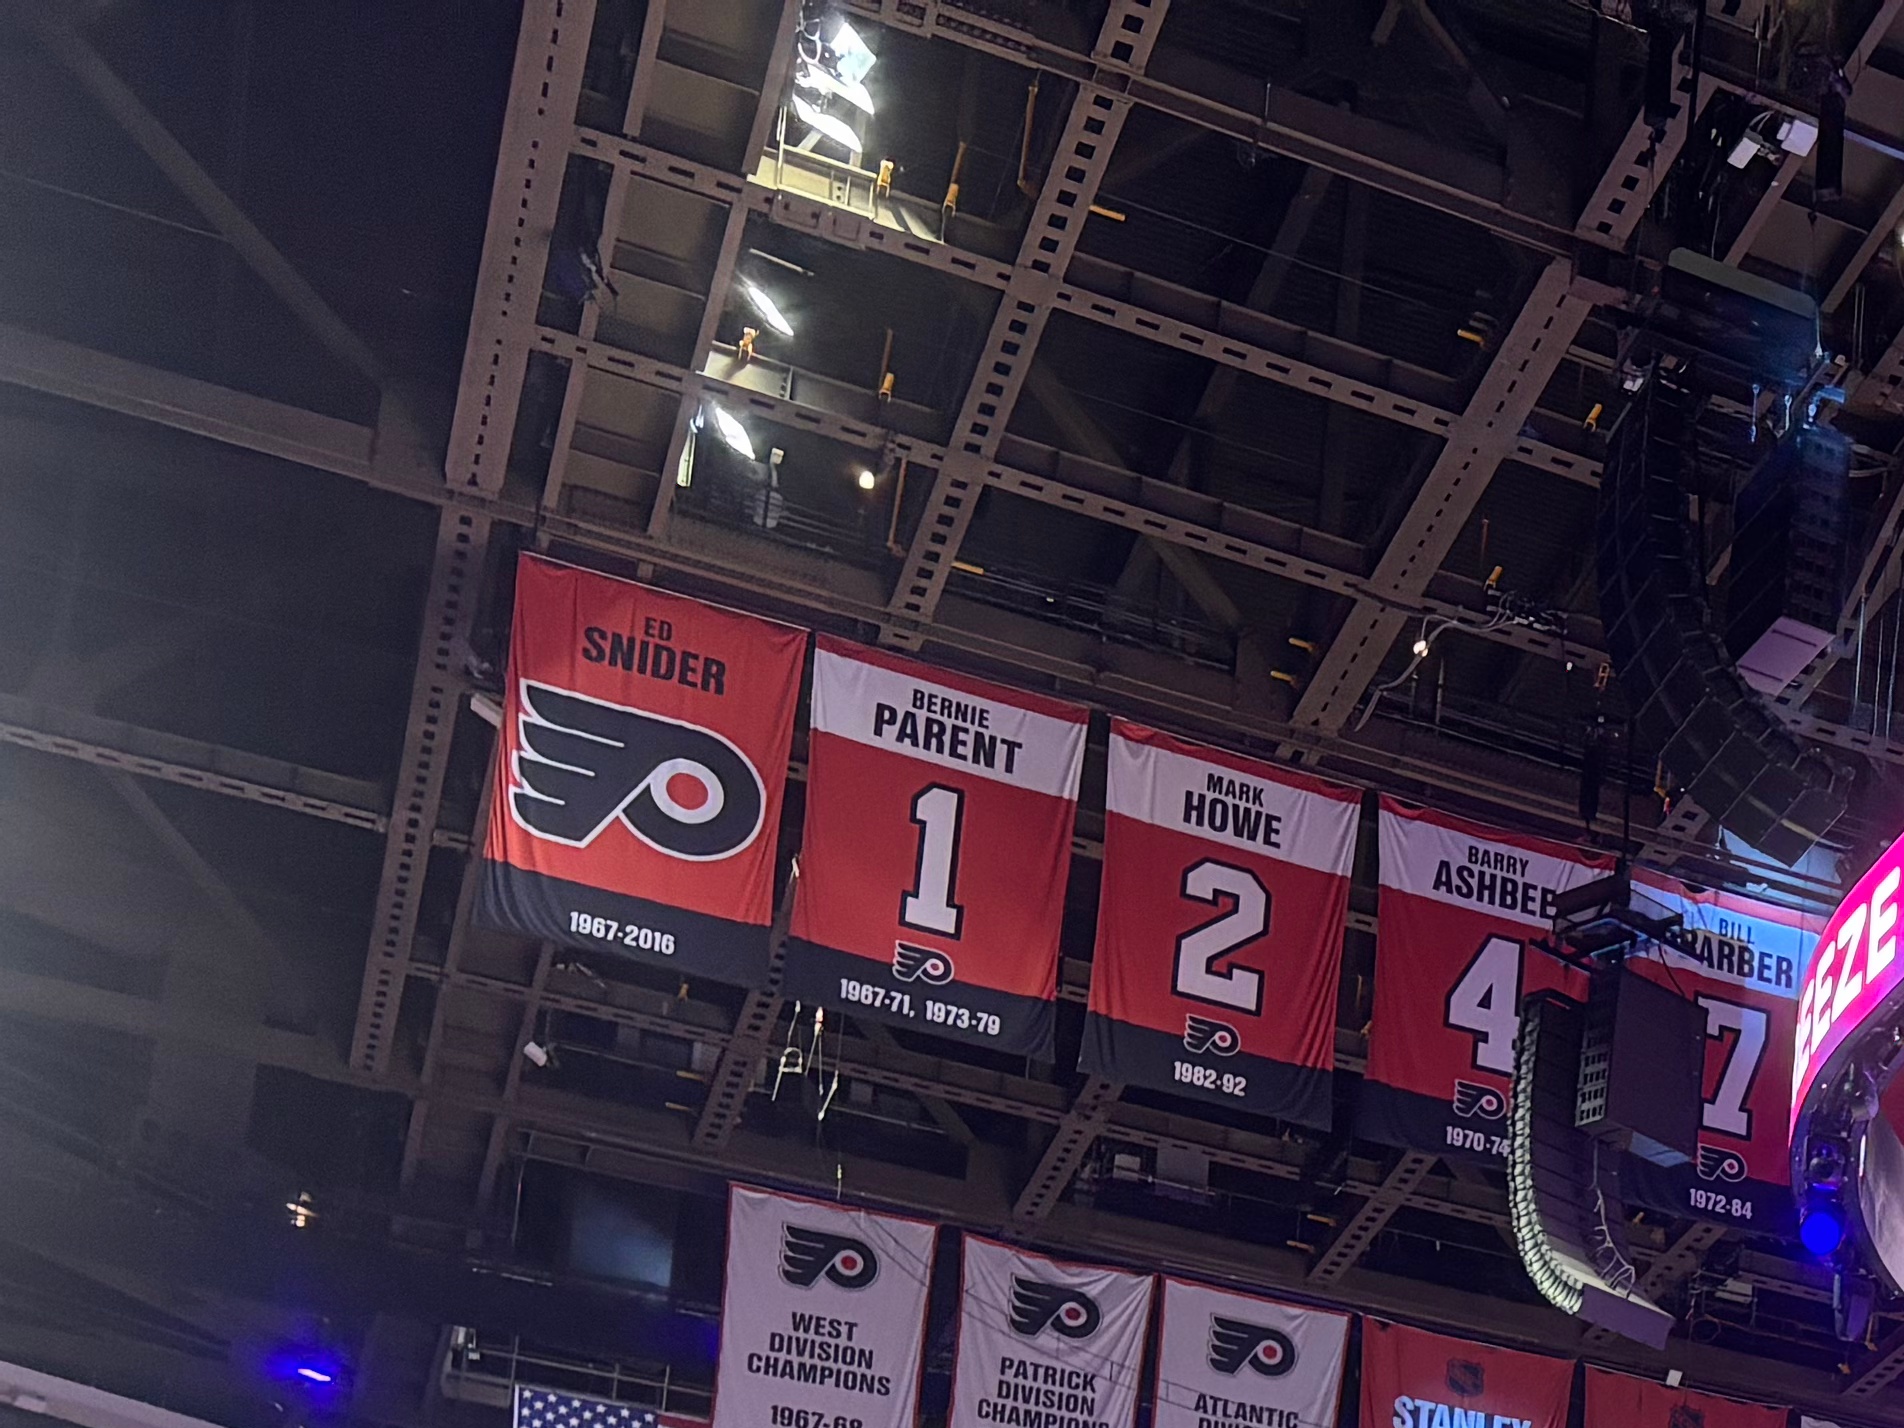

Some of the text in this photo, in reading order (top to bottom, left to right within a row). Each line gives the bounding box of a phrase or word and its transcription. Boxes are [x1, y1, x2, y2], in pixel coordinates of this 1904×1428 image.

[644, 616, 673, 642] ED
[582, 626, 726, 695] SNIDER
[911, 689, 989, 730] BERNIE
[874, 702, 1023, 775] PARENT
[1207, 773, 1264, 807] MARK
[1183, 791, 1281, 848] HOWE
[900, 782, 966, 939] 1
[1468, 846, 1529, 876] BARRY
[1433, 860, 1556, 919] ASHBEE
[569, 910, 675, 955] 1967-2016
[1172, 857, 1272, 1016] 2
[1719, 917, 1754, 945] BILL
[839, 978, 1000, 1036] 1967-71, 1973-79
[1444, 934, 1523, 1076] 4
[1173, 1061, 1246, 1097] 1982-92
[1699, 997, 1767, 1139] 7
[1446, 1126, 1511, 1157] 1970-74
[1689, 1187, 1753, 1220] 1972-84
[790, 1311, 858, 1342] WEST
[768, 1332, 874, 1369] DIVISION
[746, 1353, 891, 1396] CHAMPIONS
[1000, 1357, 1097, 1392] PATRICK
[997, 1379, 1095, 1416] DIVISION
